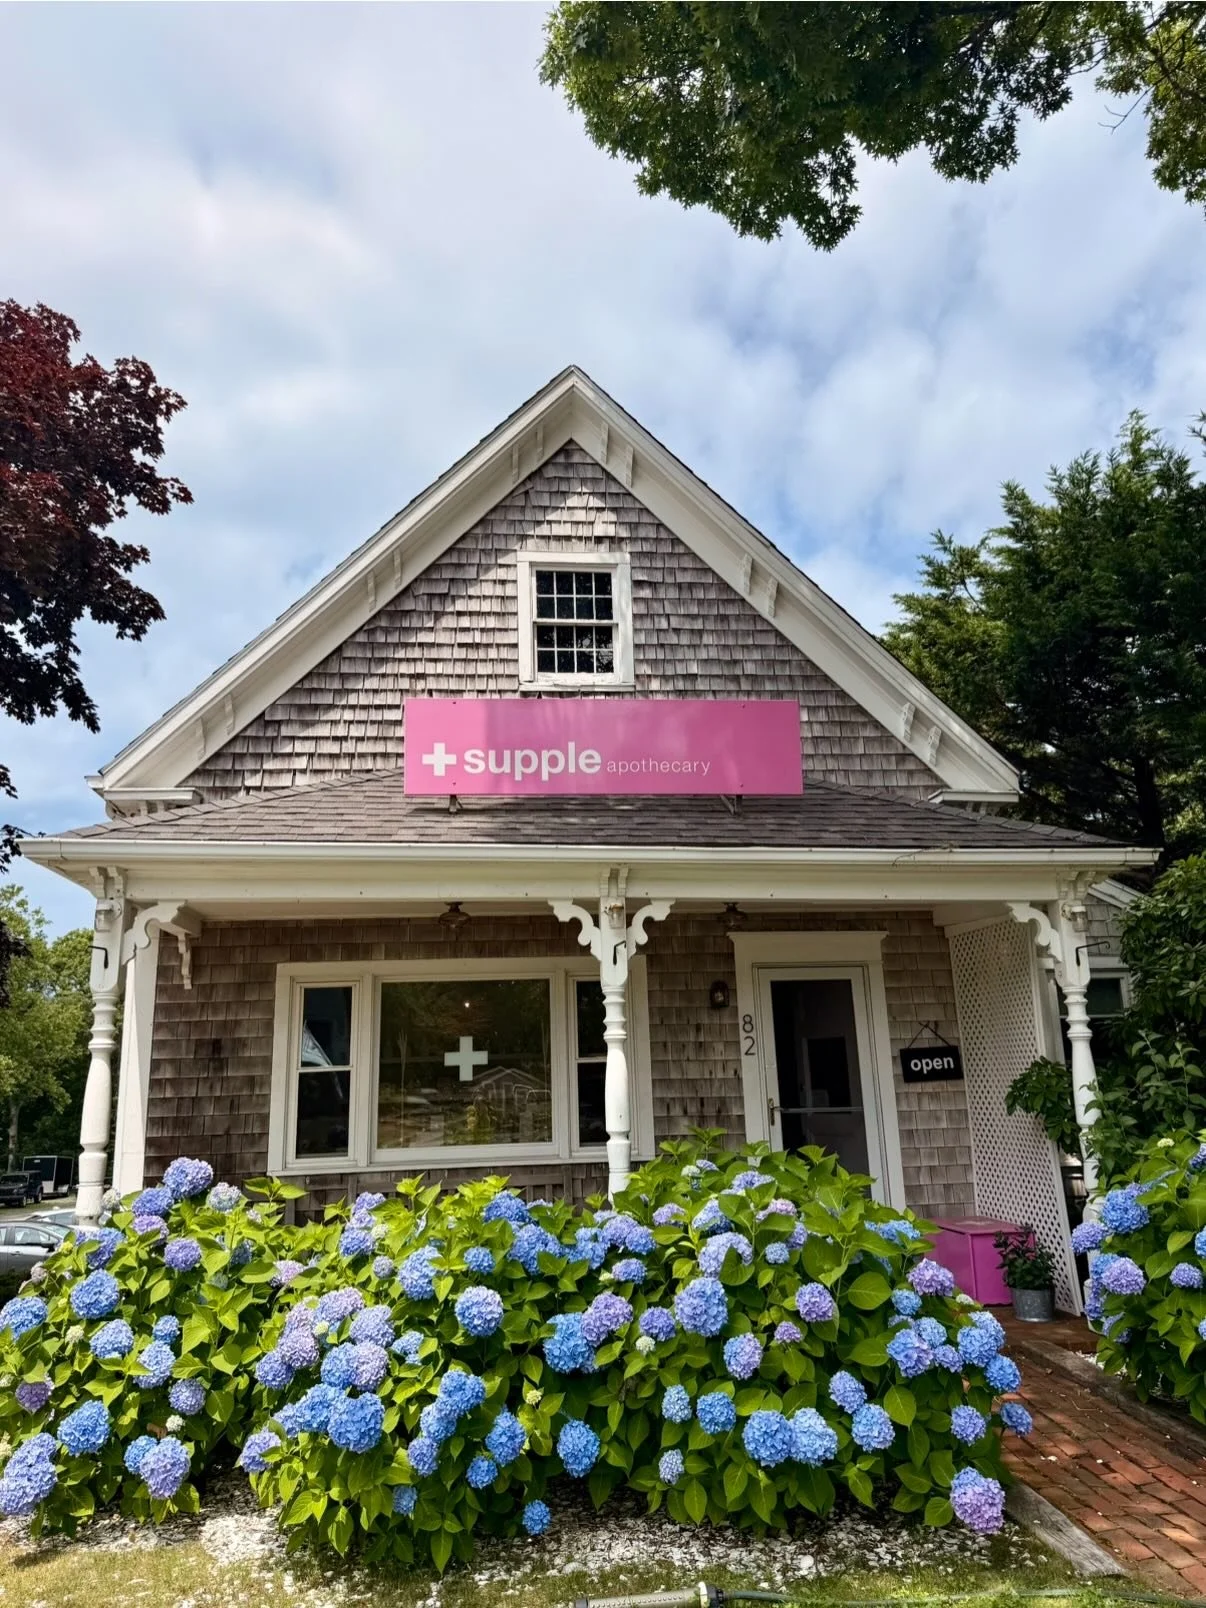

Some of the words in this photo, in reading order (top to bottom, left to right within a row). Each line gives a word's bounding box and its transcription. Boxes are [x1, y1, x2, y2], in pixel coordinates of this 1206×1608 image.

[463, 741, 601, 781] supple
[606, 757, 711, 776] apothecary
[910, 1055, 955, 1074] open
